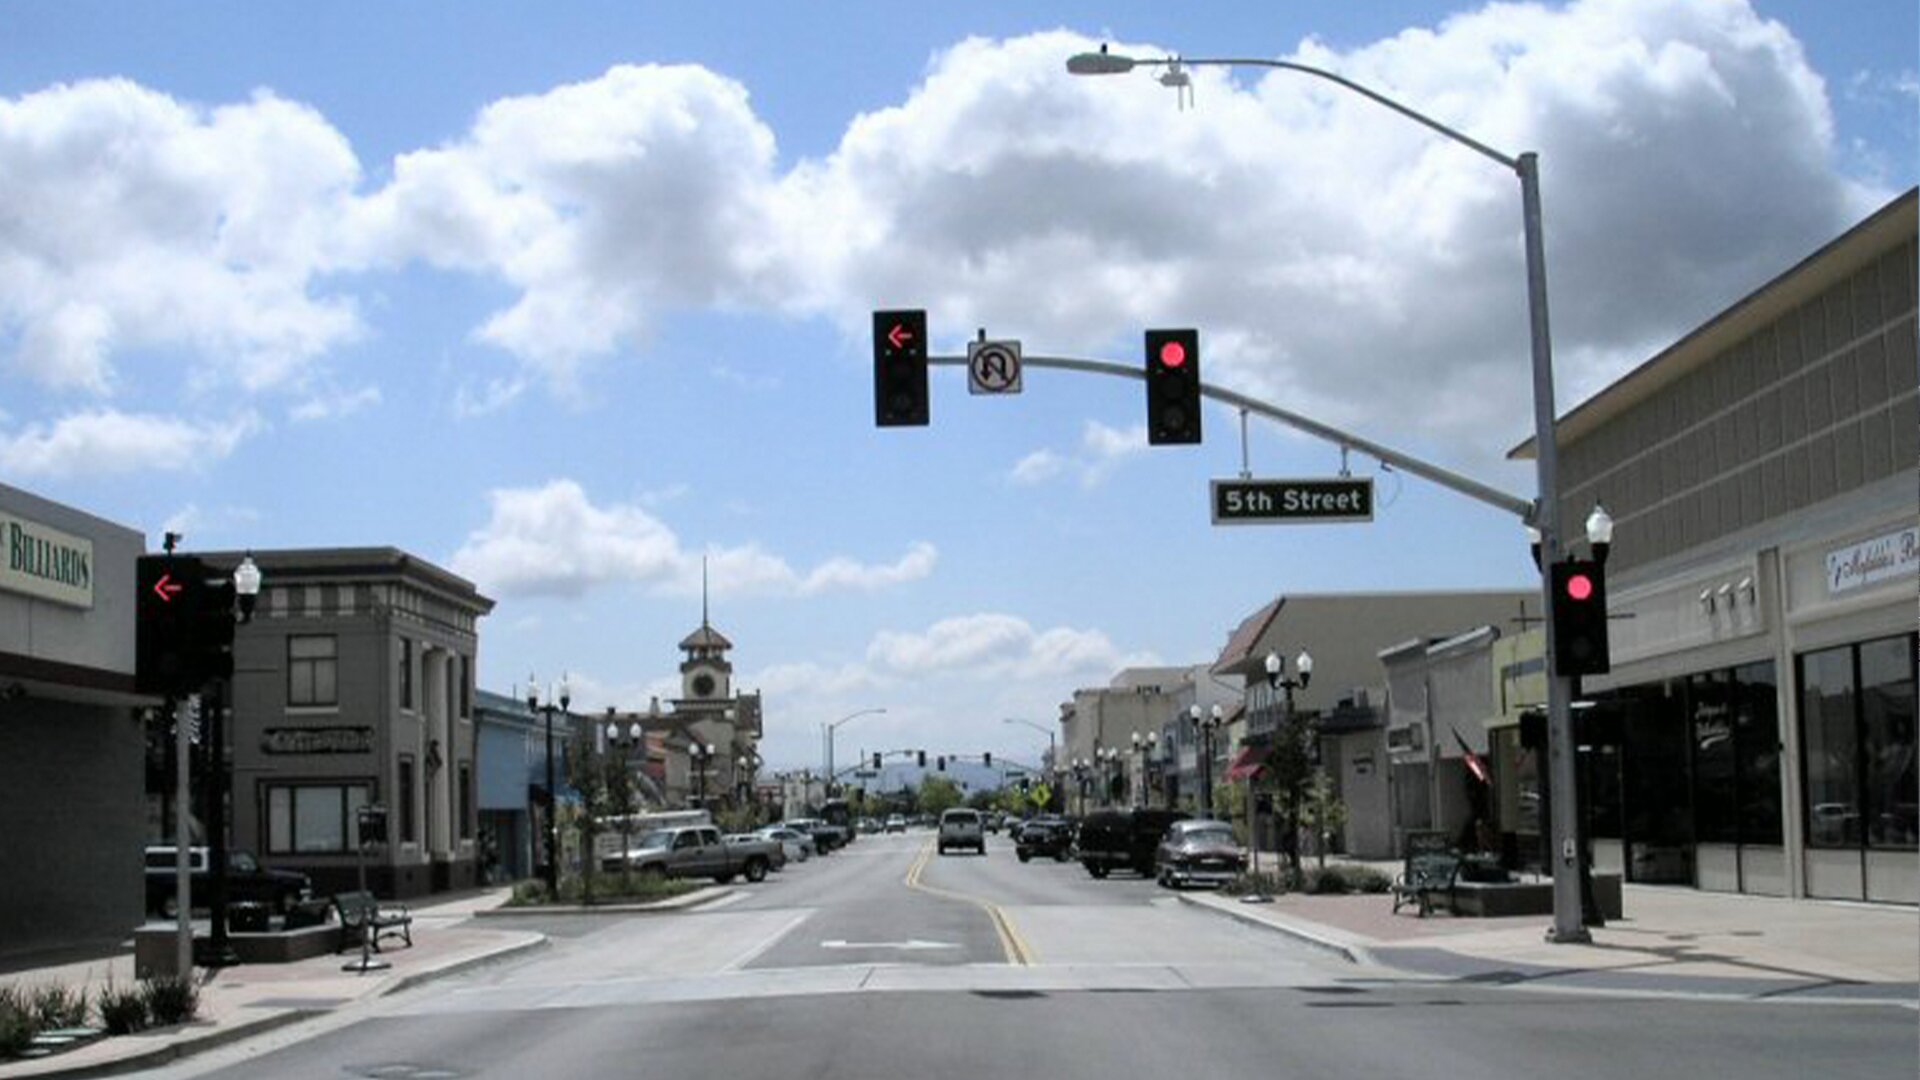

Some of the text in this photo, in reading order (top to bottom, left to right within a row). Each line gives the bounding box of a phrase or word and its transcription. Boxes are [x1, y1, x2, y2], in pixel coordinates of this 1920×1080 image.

[1225, 489, 1361, 511] 5th Street
[10, 521, 89, 589] BILLIARDS
